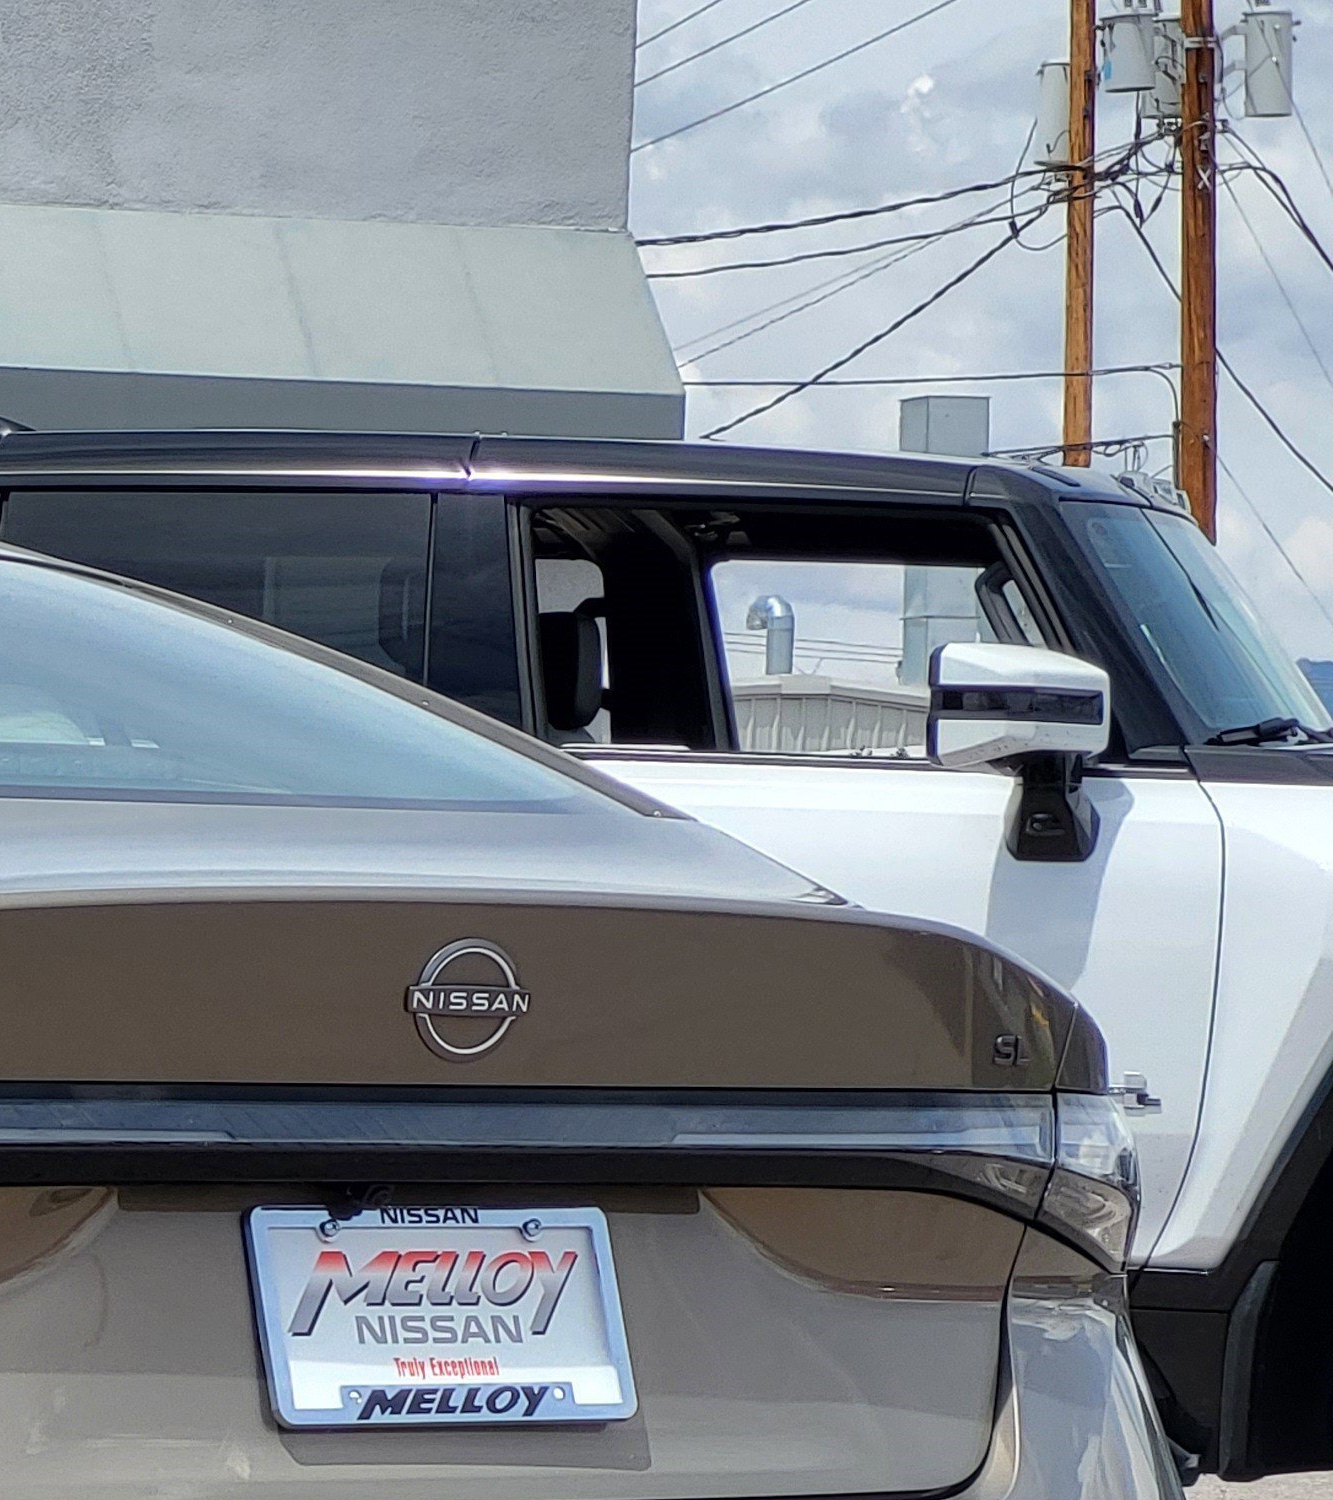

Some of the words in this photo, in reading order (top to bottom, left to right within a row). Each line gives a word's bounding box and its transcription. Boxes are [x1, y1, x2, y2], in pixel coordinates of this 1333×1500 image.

[411, 990, 530, 1014] NISSAN
[993, 1032, 1031, 1067] SL
[380, 1206, 480, 1225] NISSAN
[287, 1250, 579, 1337] MELLOY
[354, 1315, 525, 1345] NISSAN
[393, 1356, 427, 1380] Truly
[429, 1356, 501, 1379] Exceptional
[356, 1385, 551, 1421] MELLOY
